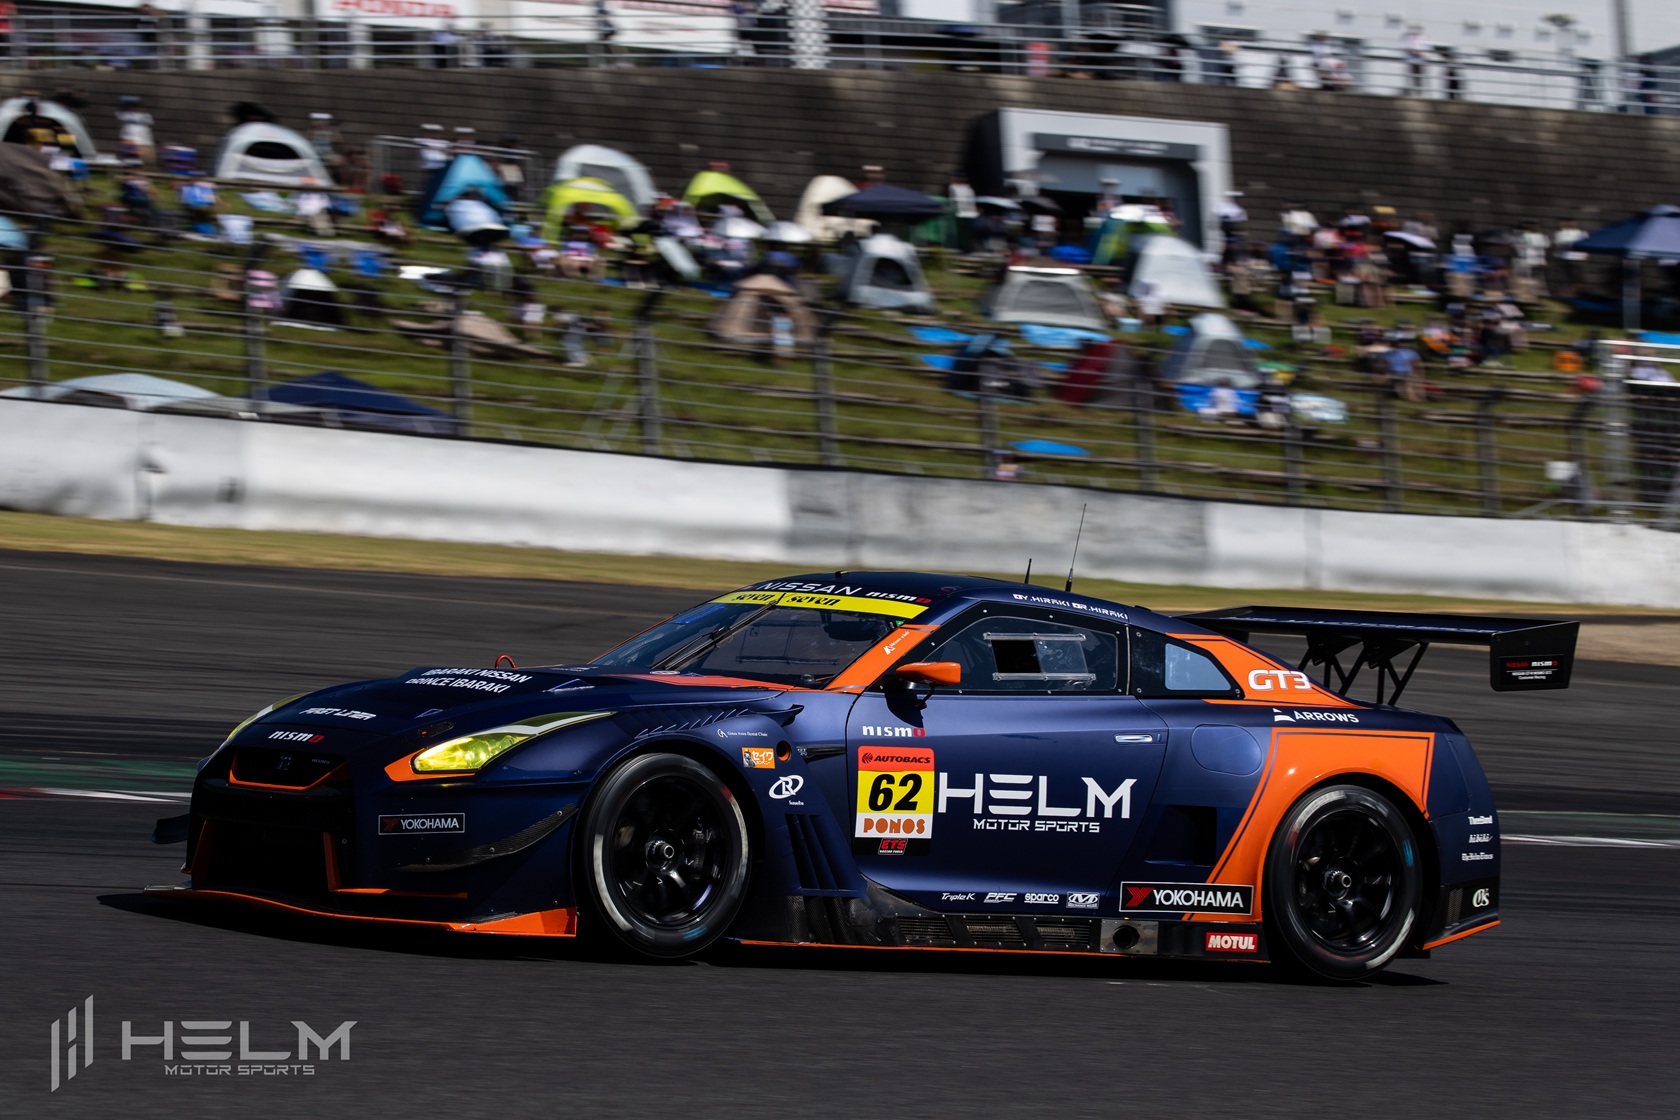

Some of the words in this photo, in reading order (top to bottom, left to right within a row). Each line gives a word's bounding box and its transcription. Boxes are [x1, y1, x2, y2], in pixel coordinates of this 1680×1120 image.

[756, 582, 862, 597] NISSAN
[865, 591, 932, 604] nismo
[474, 668, 533, 683] NISSAN
[1248, 669, 1312, 691] GT3
[448, 678, 512, 694] IBARAKI
[1294, 710, 1360, 723] ARROWS
[268, 730, 326, 744] nismo
[862, 725, 926, 738] nismo
[751, 751, 774, 761] セイワ
[873, 755, 931, 764] AUTOBACS
[868, 773, 923, 812] 62
[938, 772, 1138, 819] HELM
[400, 817, 460, 830] YOKOHAMA
[863, 817, 926, 835] PONOS
[973, 818, 1031, 832] MOTOR
[1034, 820, 1101, 834] SPORTS
[881, 839, 907, 850] ETS
[1024, 893, 1060, 903] sparco
[1152, 889, 1244, 908] YOKOHAMA
[1208, 935, 1256, 950] MOTUL
